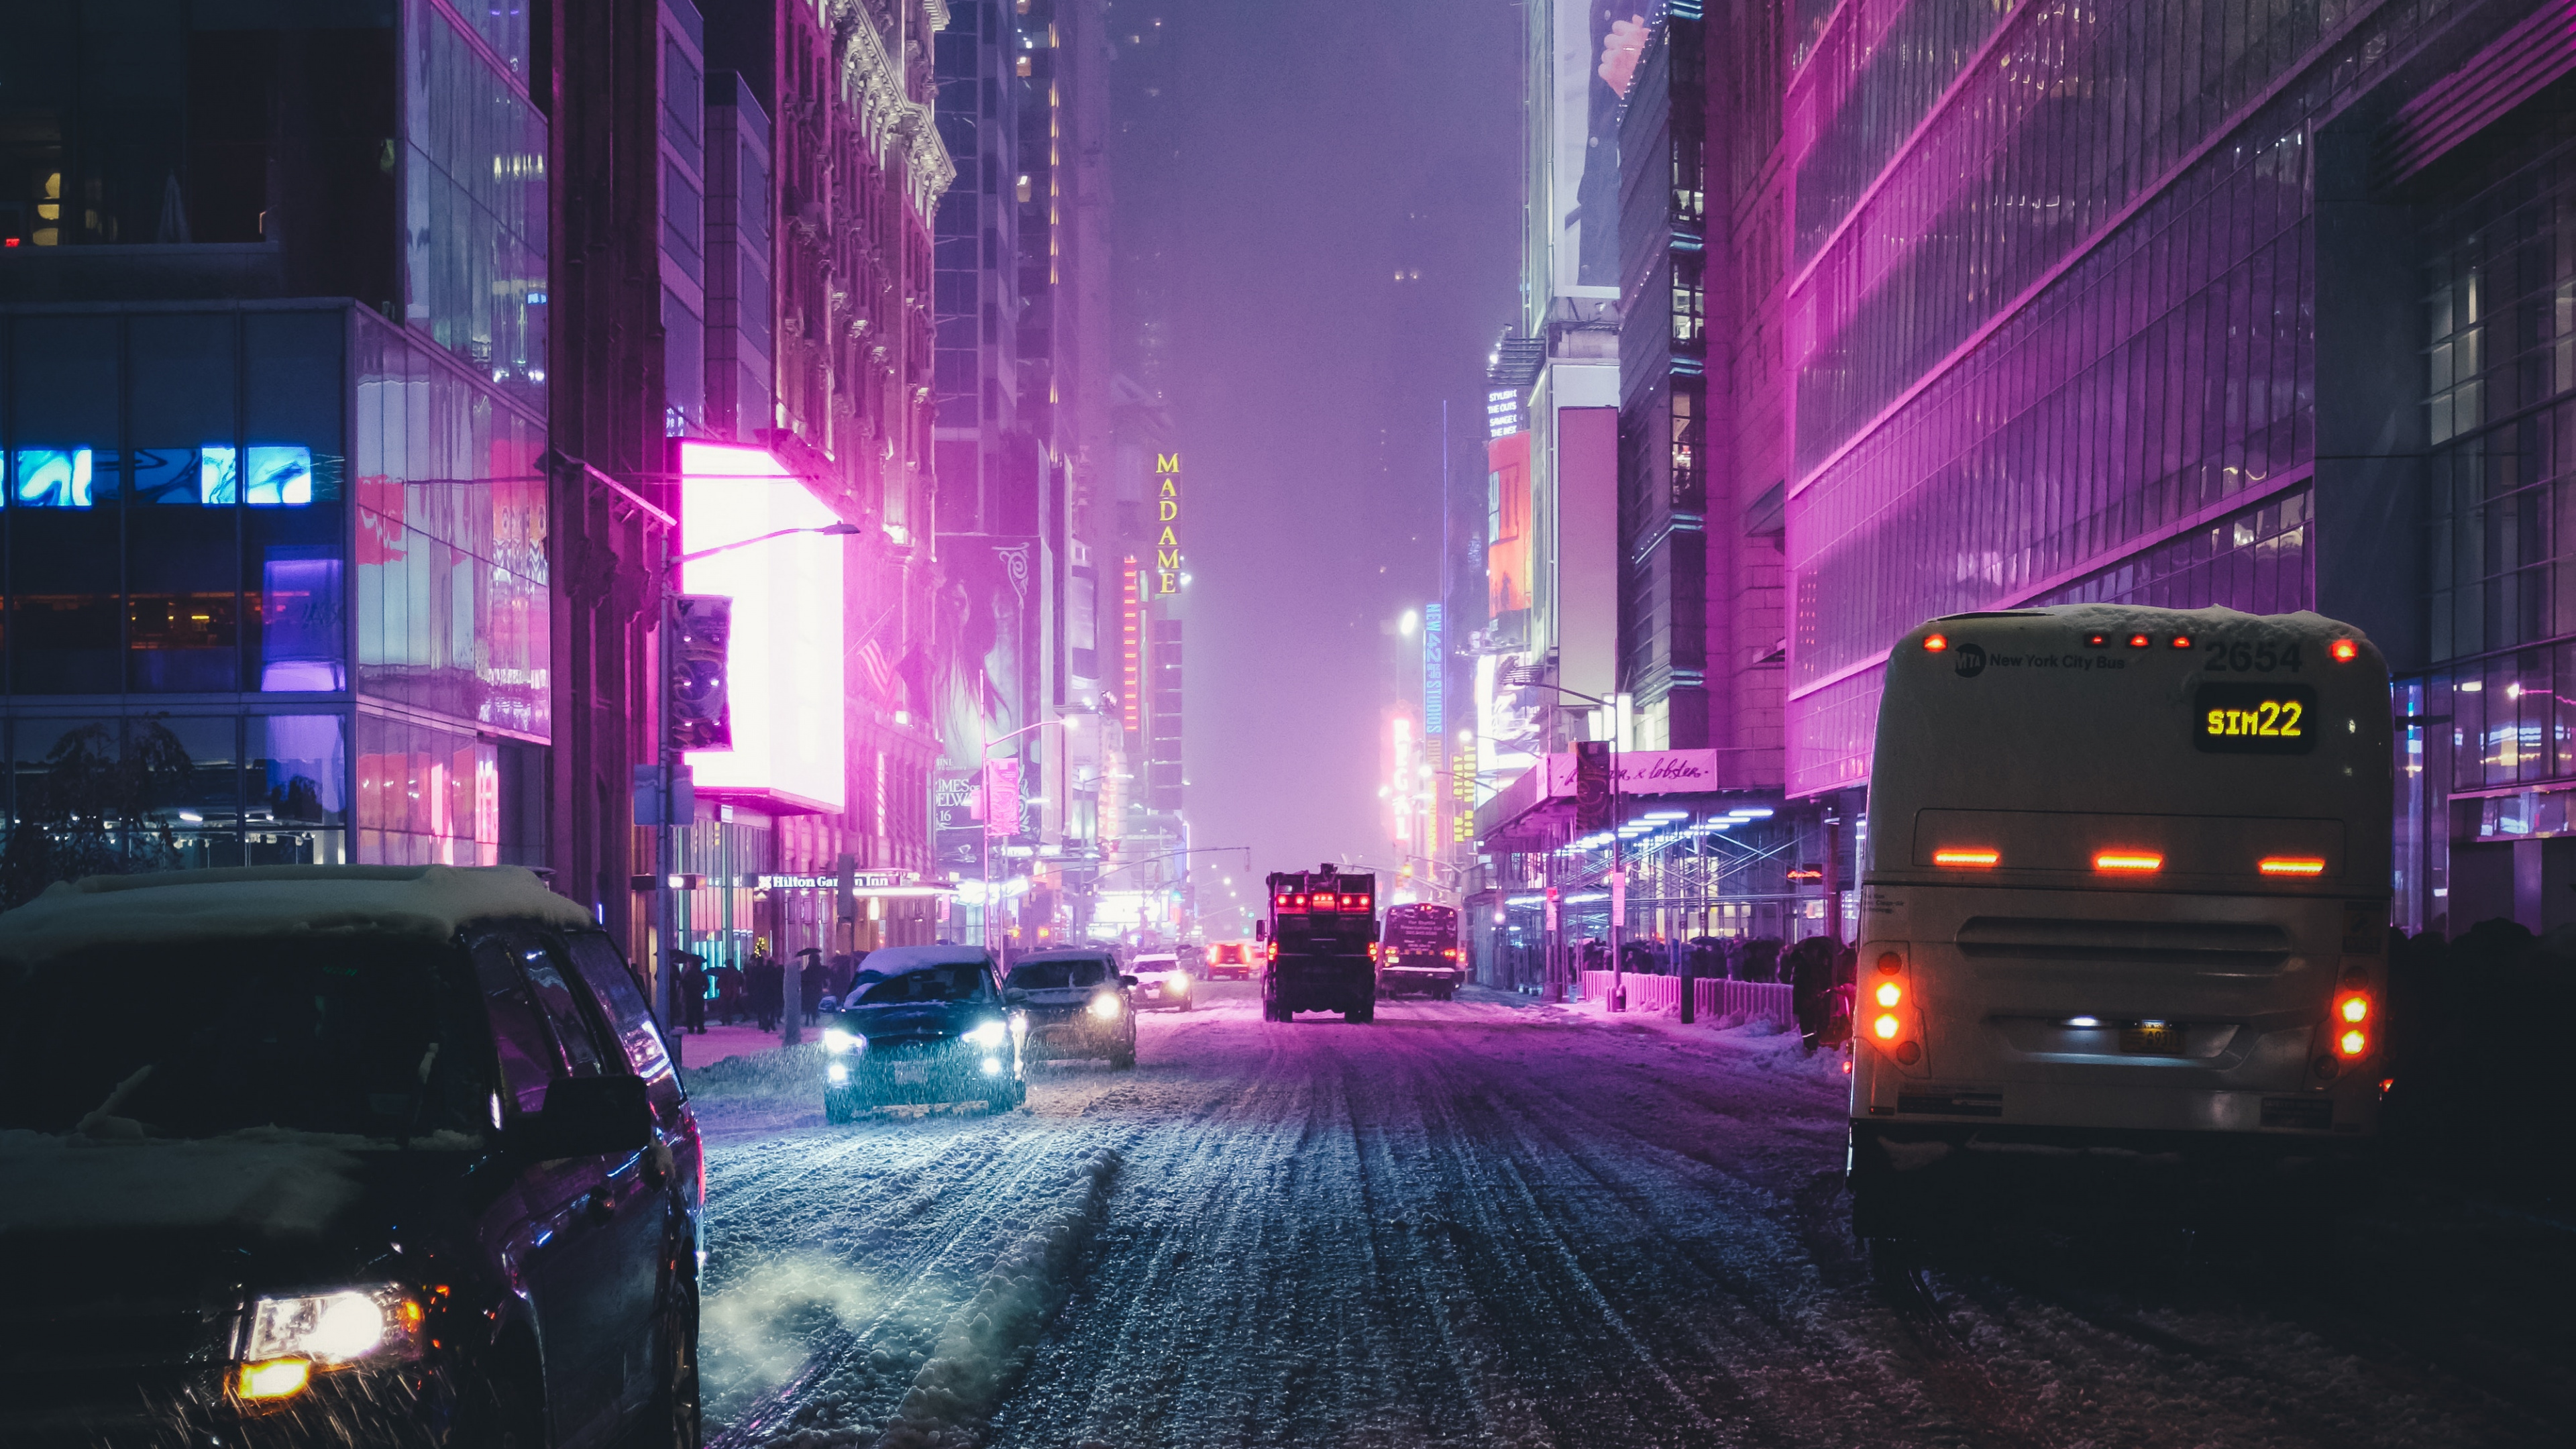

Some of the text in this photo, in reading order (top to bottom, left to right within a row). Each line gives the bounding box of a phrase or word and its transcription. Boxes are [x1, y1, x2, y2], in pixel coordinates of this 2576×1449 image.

[1487, 405, 1499, 414] THE
[1491, 428, 1503, 437] THE
[1155, 453, 1181, 593] MADAME
[1426, 604, 1442, 632] NEW
[1955, 651, 2125, 670] MTA New York City Bus
[2204, 641, 2302, 673] 2654
[1426, 680, 1442, 733] STUDIOS
[2208, 700, 2303, 736] SIM22
[935, 778, 969, 792] IMES
[1393, 719, 1411, 839] REGAL
[940, 810, 951, 821] 16
[773, 875, 889, 888] Hilton Garn Inn
